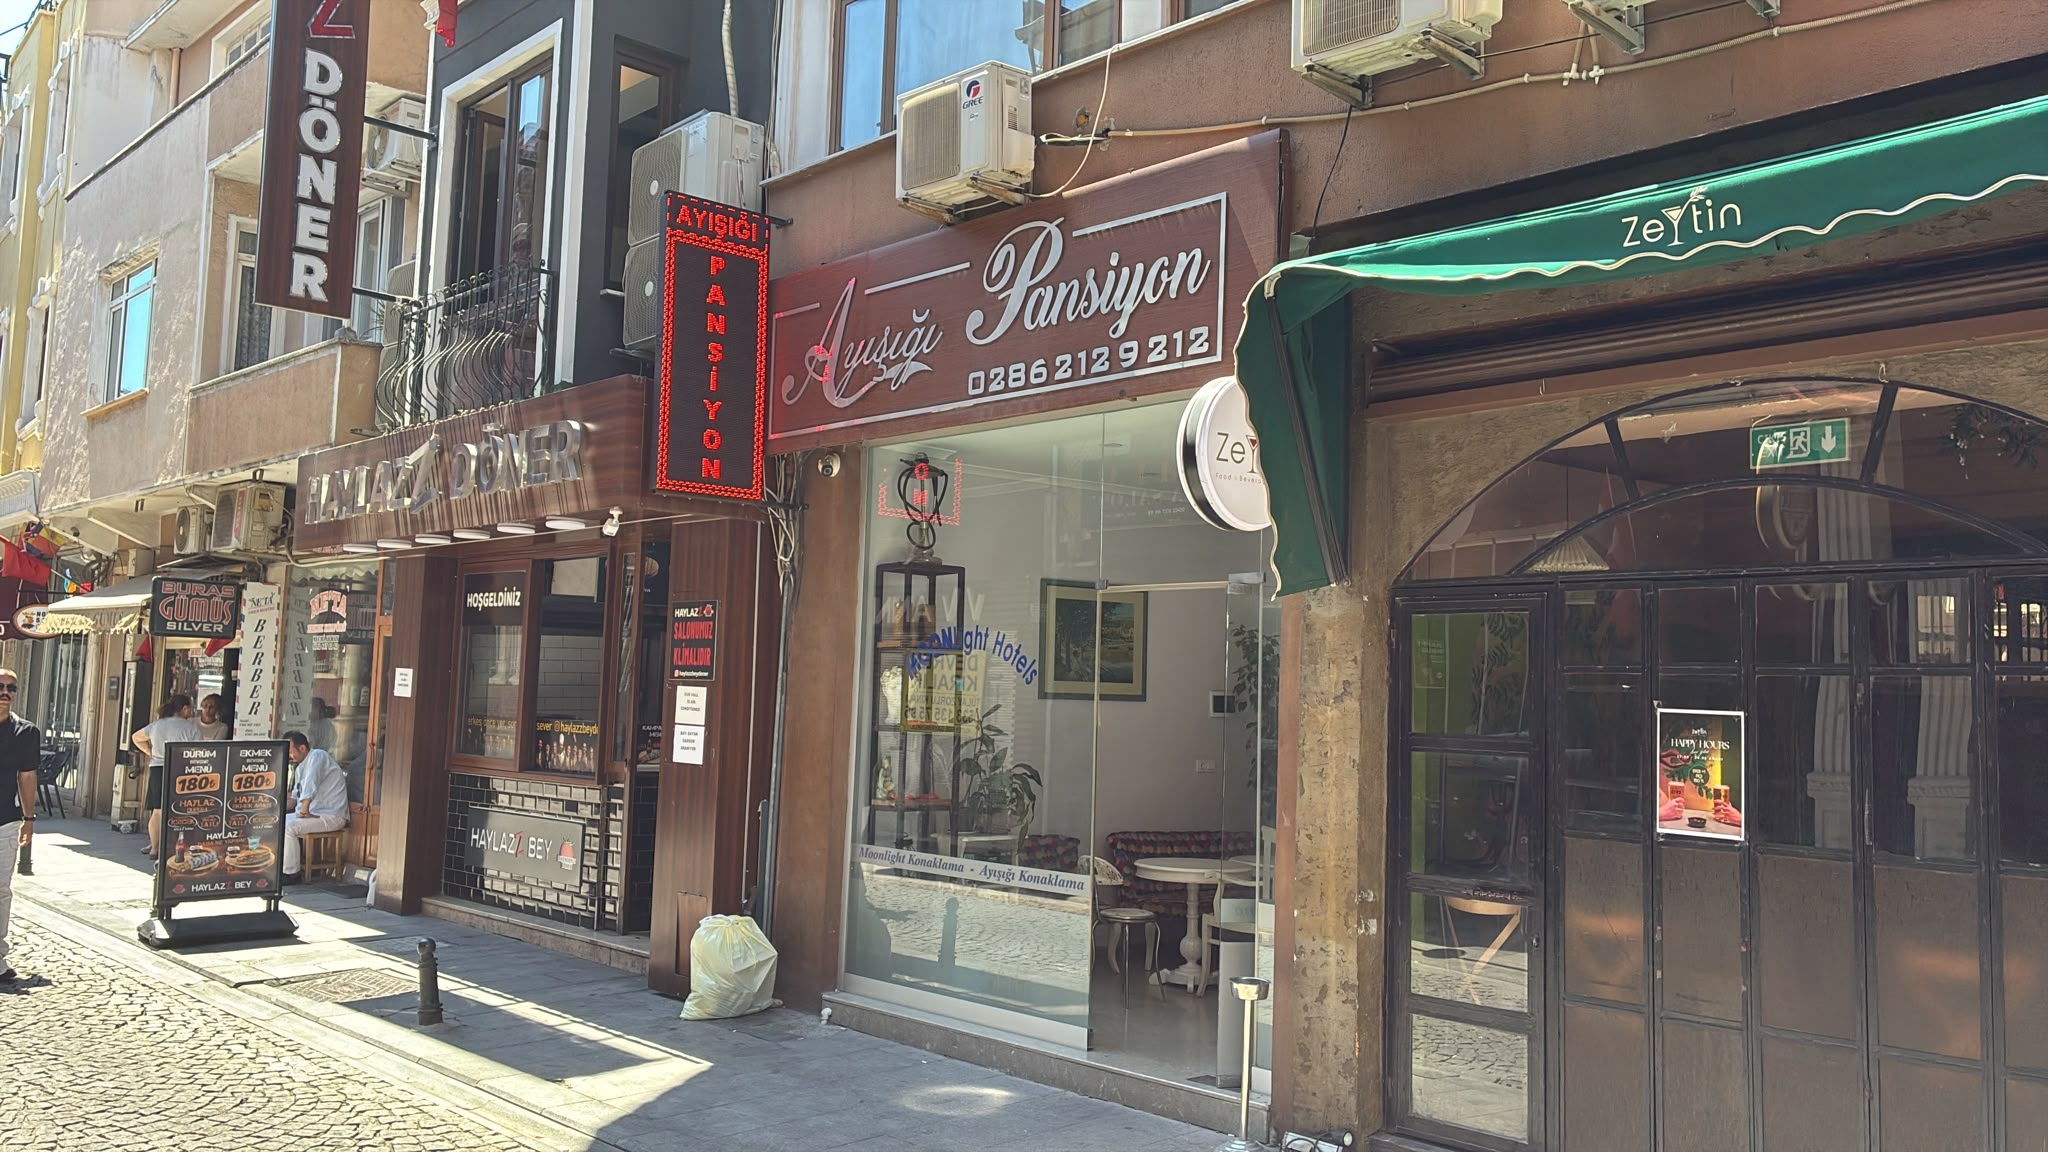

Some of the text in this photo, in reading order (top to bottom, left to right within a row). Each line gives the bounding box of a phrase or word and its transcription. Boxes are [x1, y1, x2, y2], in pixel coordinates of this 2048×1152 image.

[962, 96, 984, 110] GREE
[290, 47, 343, 302] DÖNER
[676, 204, 758, 242] AYIŞIĞI
[1621, 187, 1742, 248] Zeytin
[781, 217, 1212, 408] Ayışığı Pansiyon
[701, 255, 726, 480] PANSİYON
[449, 419, 587, 500] DÖNER
[161, 581, 235, 598] BURAS
[466, 586, 521, 611] HOŞGELDİNİZ
[158, 595, 235, 626] GÜMÜŞ
[166, 621, 223, 633] SILVER
[674, 621, 713, 640] SALONUMUZ
[249, 618, 267, 716] BERBER
[992, 631, 1038, 685] Hotels
[536, 721, 552, 731] sever
[183, 749, 217, 759] DÜRÜM
[240, 749, 272, 758] EKMEK
[1671, 739, 1730, 752] HAPPY HOURS
[185, 764, 213, 774] MENÜ
[241, 762, 269, 772] MENÜ
[528, 836, 552, 860] BEY
[859, 846, 906, 865] Moonlight
[908, 853, 965, 873] Konaklama
[979, 865, 1015, 883] Ayışığı
[1019, 870, 1085, 891] Konaklama
[234, 880, 252, 889] BEY
